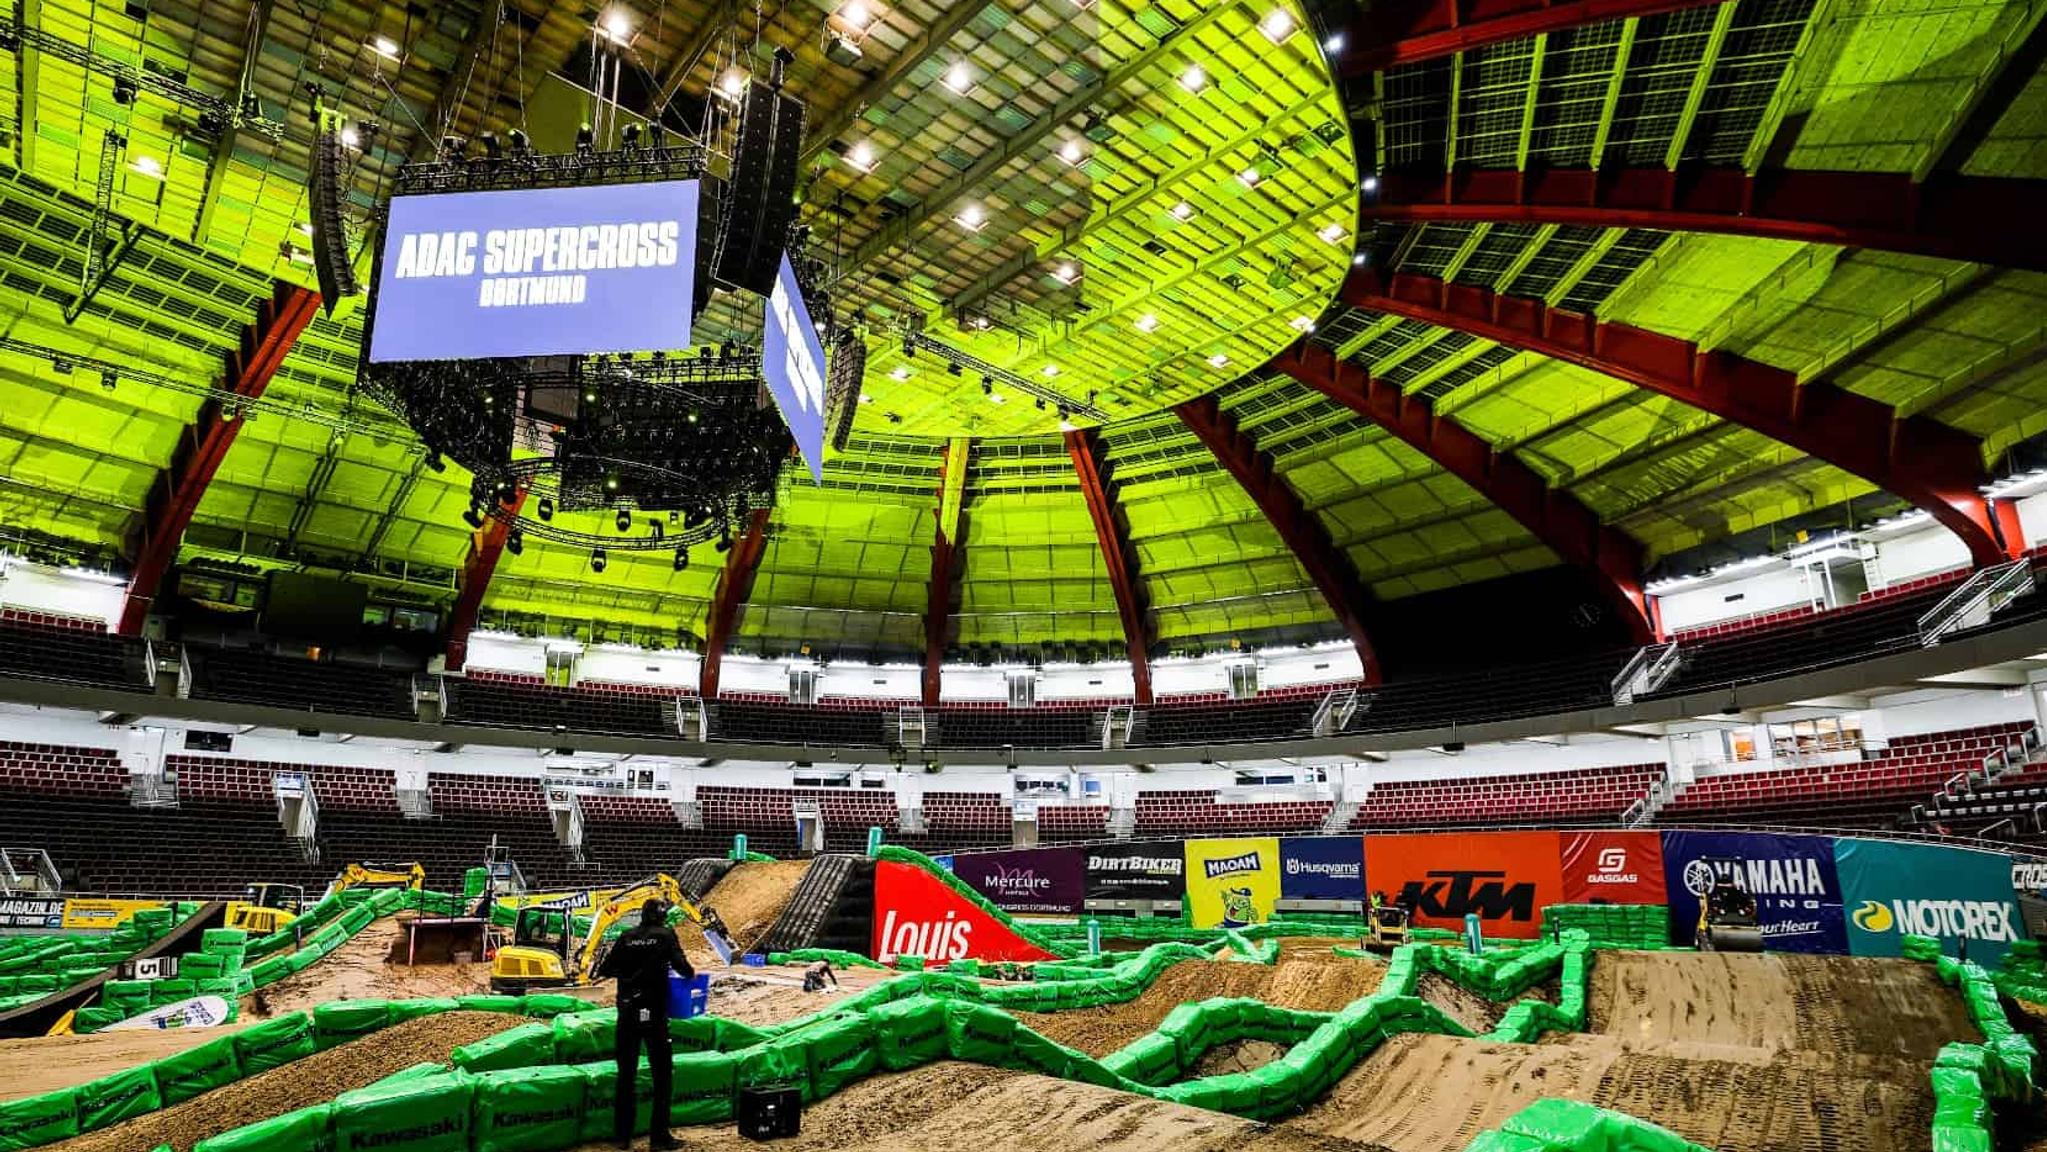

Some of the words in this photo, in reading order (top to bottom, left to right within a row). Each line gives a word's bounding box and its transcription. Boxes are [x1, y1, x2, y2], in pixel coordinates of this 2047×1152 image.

[395, 231, 478, 279] ADAC
[483, 221, 679, 273] SUPERCROSS
[479, 275, 587, 307] DORTMUND
[985, 875, 1051, 889] Mercure
[1300, 862, 1361, 875] Husqvarna
[1587, 874, 1637, 883] GASGAS
[1714, 858, 1826, 895] YAMAHA
[1403, 871, 1536, 921] KTM
[879, 910, 972, 963] Louis
[1893, 899, 2019, 942] MOTOREX
[351, 1114, 464, 1149] Kawasaki
